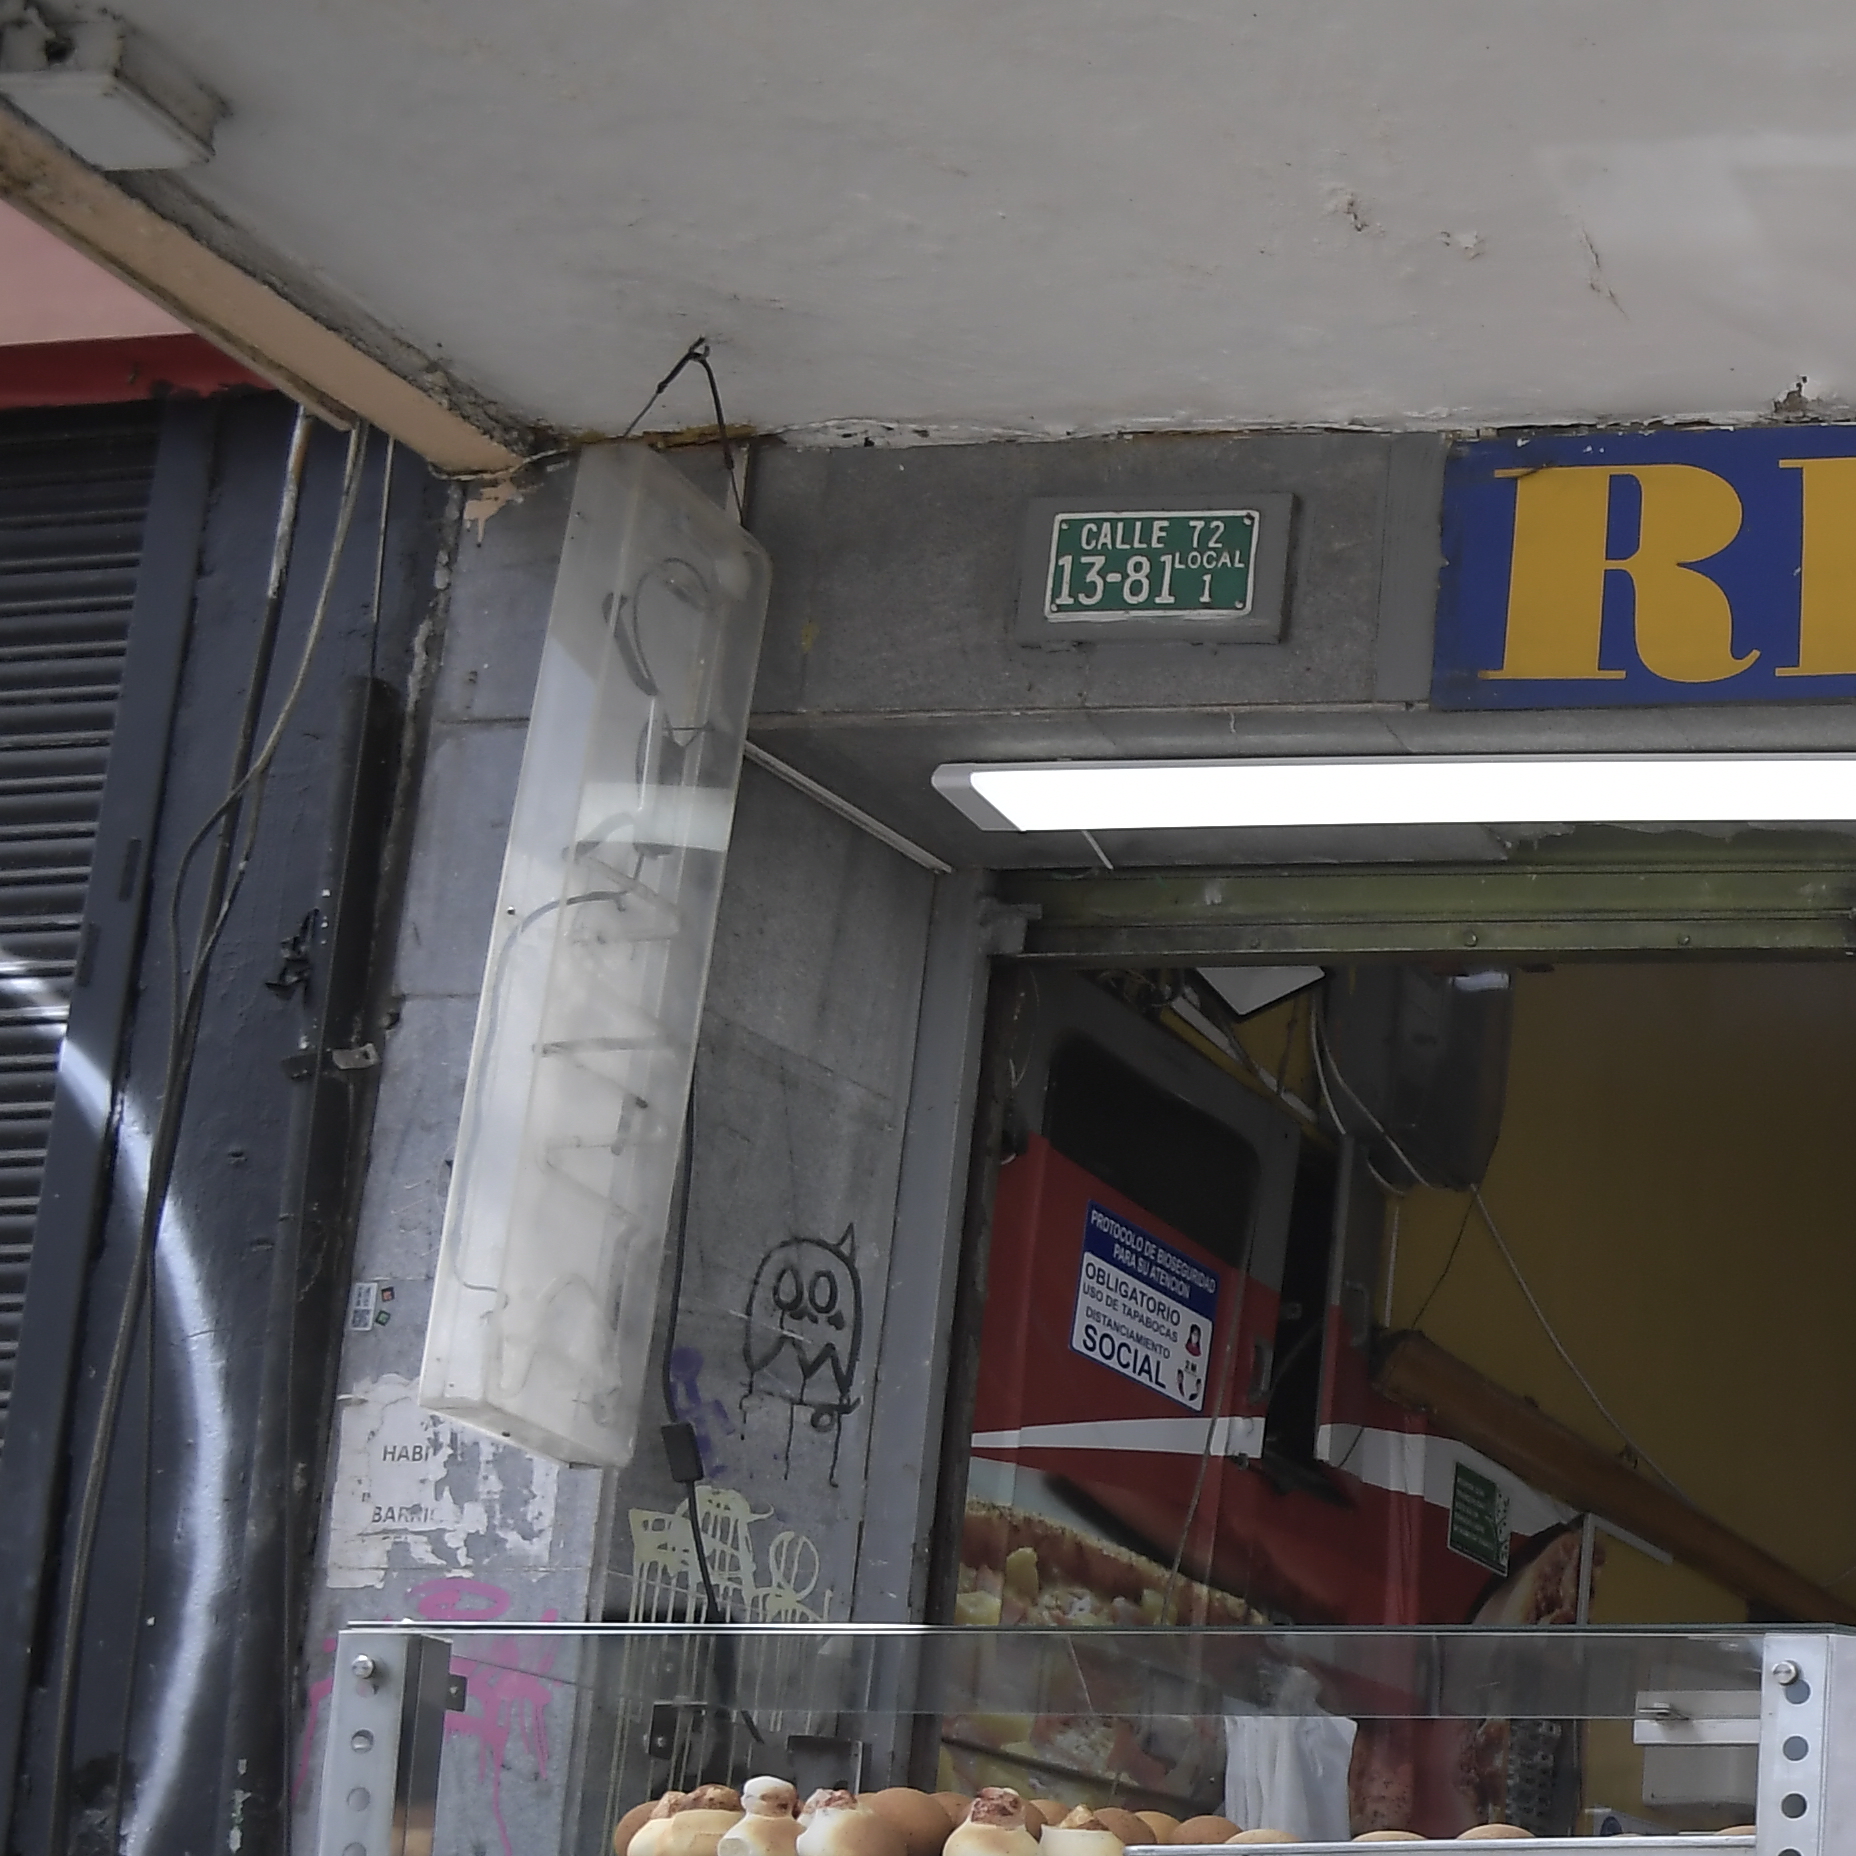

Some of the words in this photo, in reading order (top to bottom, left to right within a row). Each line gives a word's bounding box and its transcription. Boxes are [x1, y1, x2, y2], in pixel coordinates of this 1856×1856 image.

[1081, 520, 1170, 551] CALLE
[1189, 520, 1225, 548] 72
[1054, 554, 1176, 606] 13-81
[1174, 550, 1246, 569] LOCAL
[1199, 573, 1213, 603] 1
[1090, 1209, 1144, 1252] PROTOCOLO
[1144, 1239, 1158, 1260] DE
[1157, 1248, 1217, 1295] BIOSEGURIDAD
[1113, 1243, 1137, 1270] PARA
[1137, 1255, 1151, 1277] SU
[1082, 1282, 1103, 1303] USO
[1105, 1294, 1119, 1312] DE
[1121, 1304, 1179, 1344] TAPABOCAS
[1085, 1262, 1181, 1327] OBLIGATORIO
[1085, 1305, 1171, 1360] DISTANCIAMIENTO
[1082, 1324, 1167, 1390] SOCIAL
[382, 1444, 431, 1462] HABI
[371, 1505, 435, 1523] BARRI
